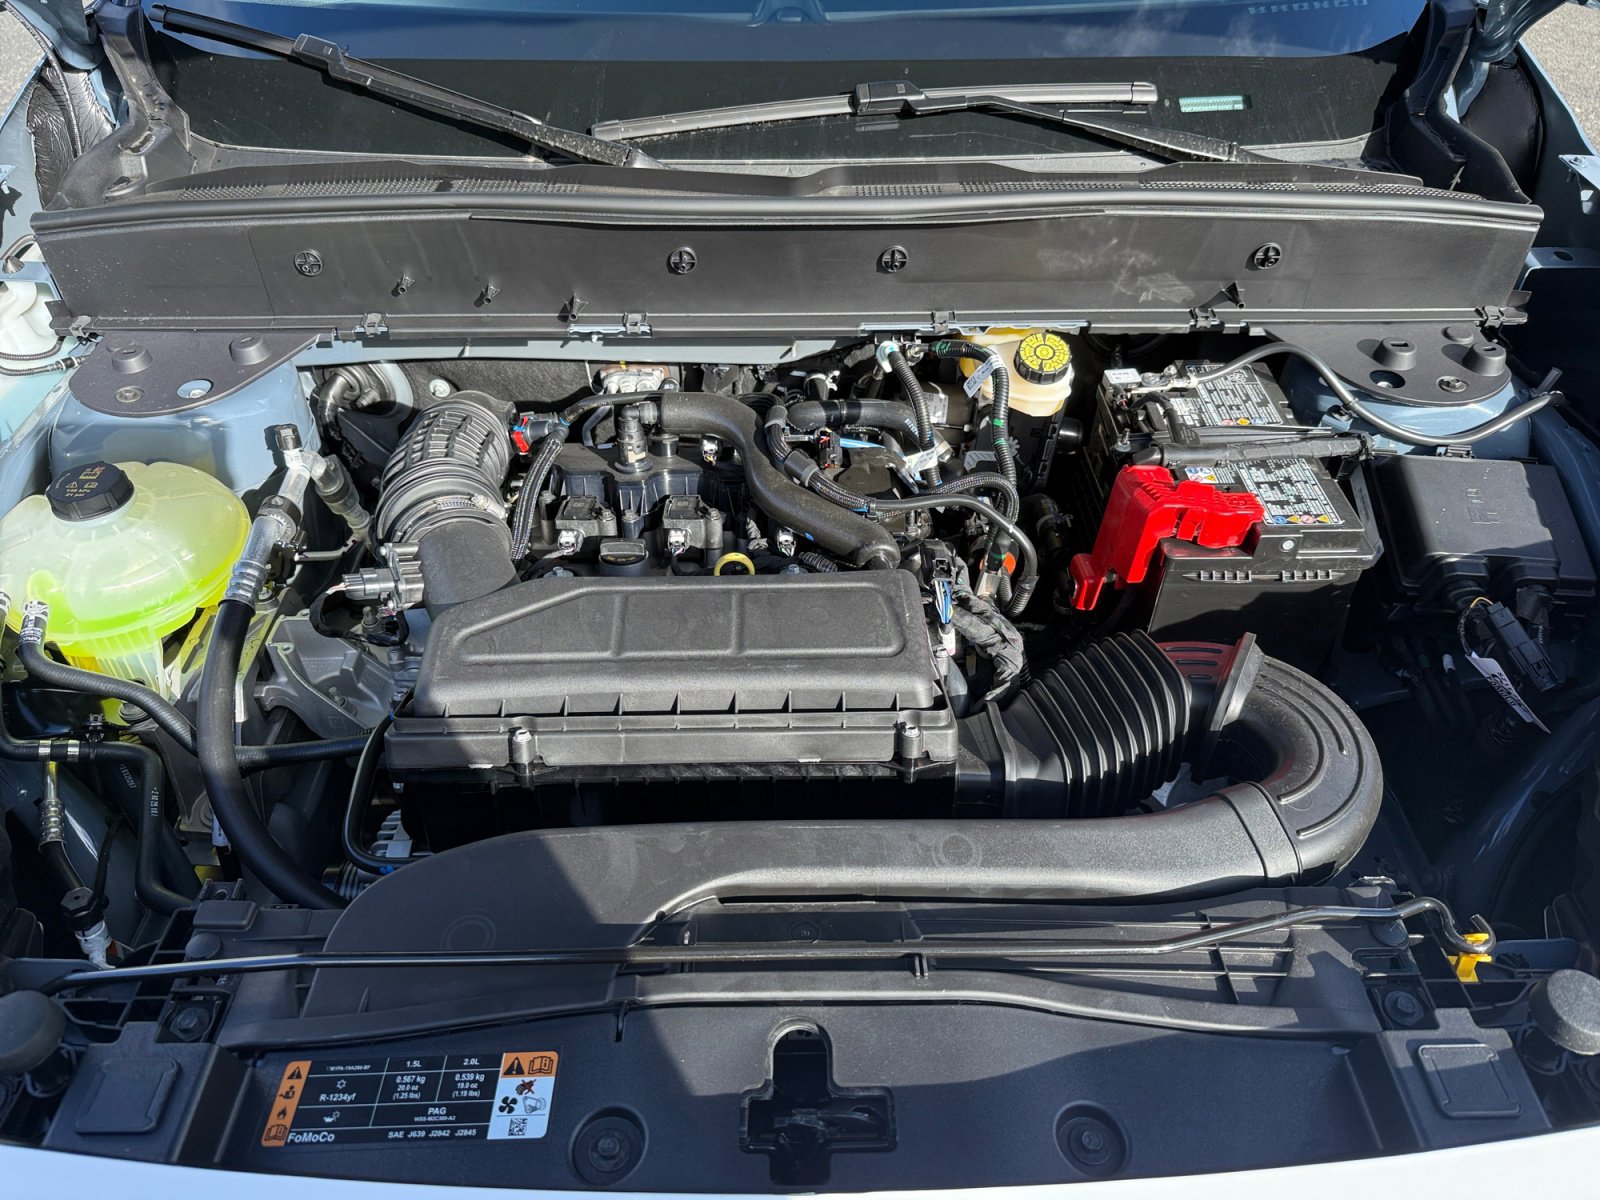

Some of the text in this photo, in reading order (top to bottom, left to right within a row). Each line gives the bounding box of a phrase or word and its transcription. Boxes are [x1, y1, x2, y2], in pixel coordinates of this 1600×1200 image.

[396, 1075, 426, 1084] 0.567 kg
[455, 1073, 485, 1082] 0.539 kg
[319, 1092, 357, 1102] R-1234yf
[409, 1092, 421, 1100] lbs)
[468, 1090, 480, 1098] lbs)
[427, 1107, 447, 1115] PAG
[287, 1132, 335, 1143] FoMoCo
[387, 1130, 404, 1138] SAE
[408, 1130, 426, 1138] J639
